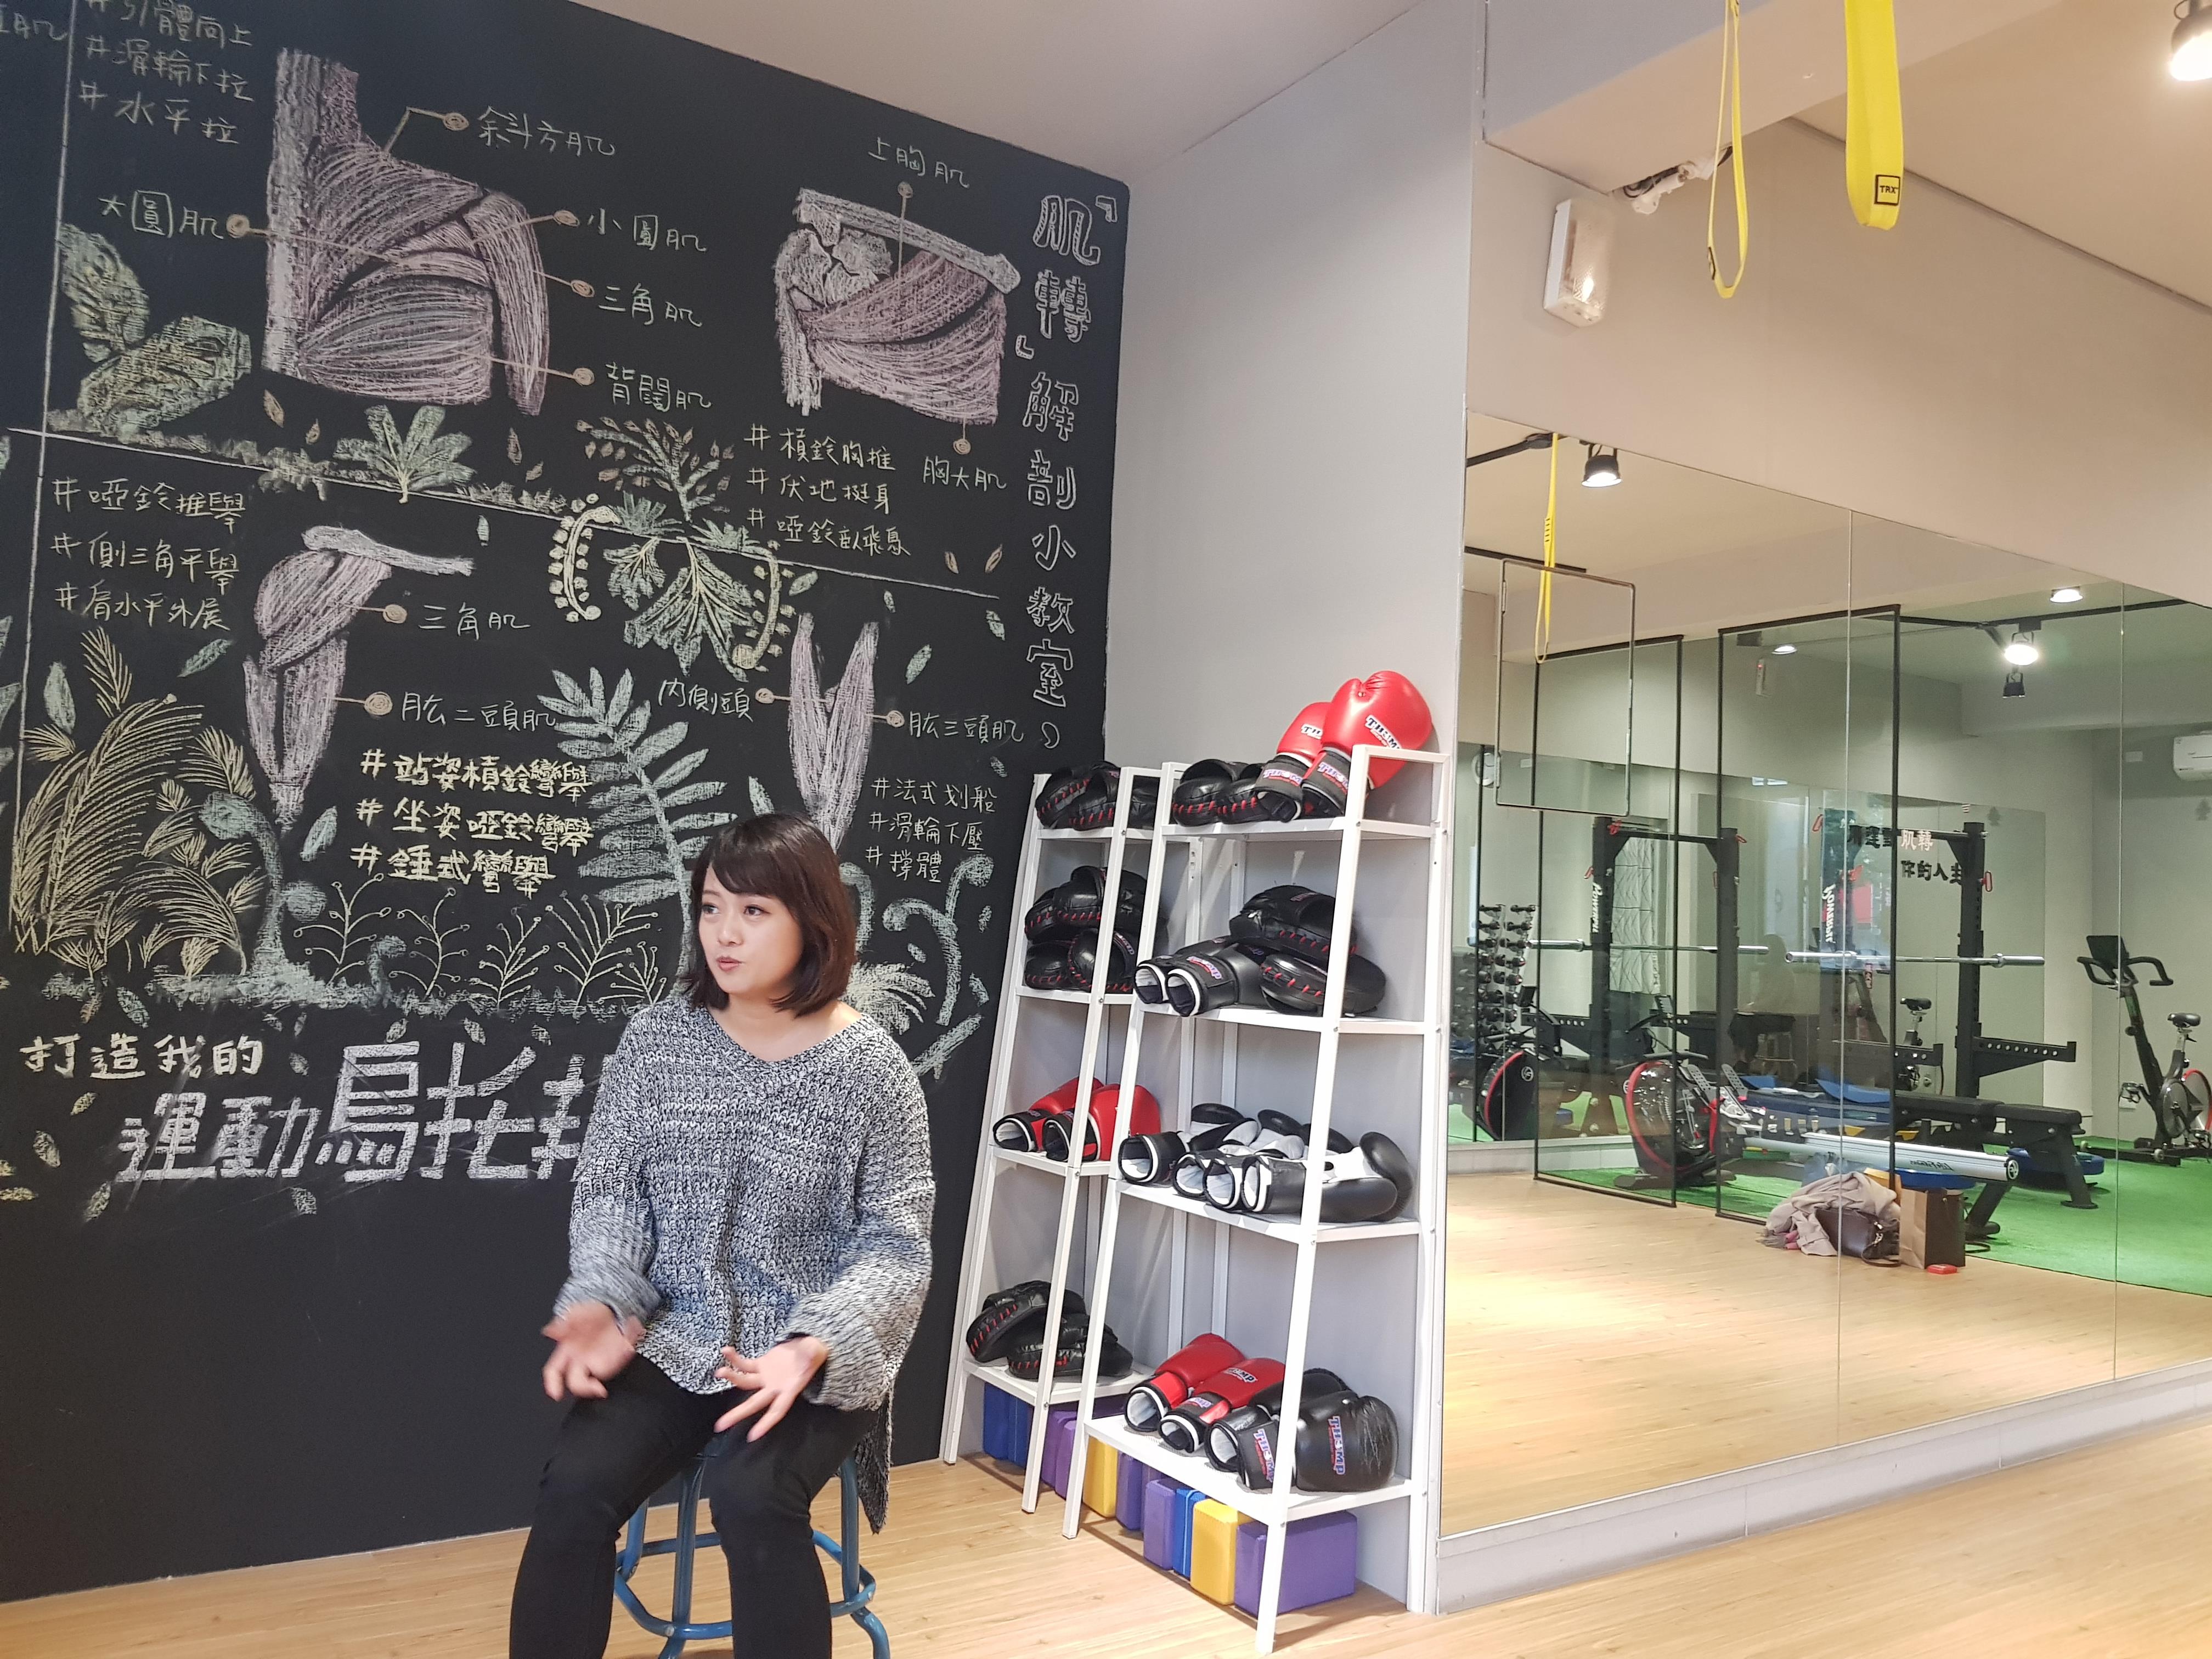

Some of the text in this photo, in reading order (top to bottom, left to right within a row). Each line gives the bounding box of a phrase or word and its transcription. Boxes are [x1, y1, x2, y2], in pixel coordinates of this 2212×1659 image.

[478, 106, 615, 156] 斜方肌
[868, 137, 970, 188] 上胸肌
[1880, 185, 1898, 194] TRX
[99, 190, 224, 239] 大圓肌
[588, 208, 707, 252] 小圓肌
[599, 283, 702, 328] 三角肌
[605, 361, 711, 412] 背闊肌
[923, 455, 1007, 492] 胸大肌
[419, 602, 530, 640] 三角肌
[402, 691, 556, 732] 肱二頭肌
[909, 711, 1024, 744] 肱三頭肌
[20, 1032, 263, 1079] 打造我的
